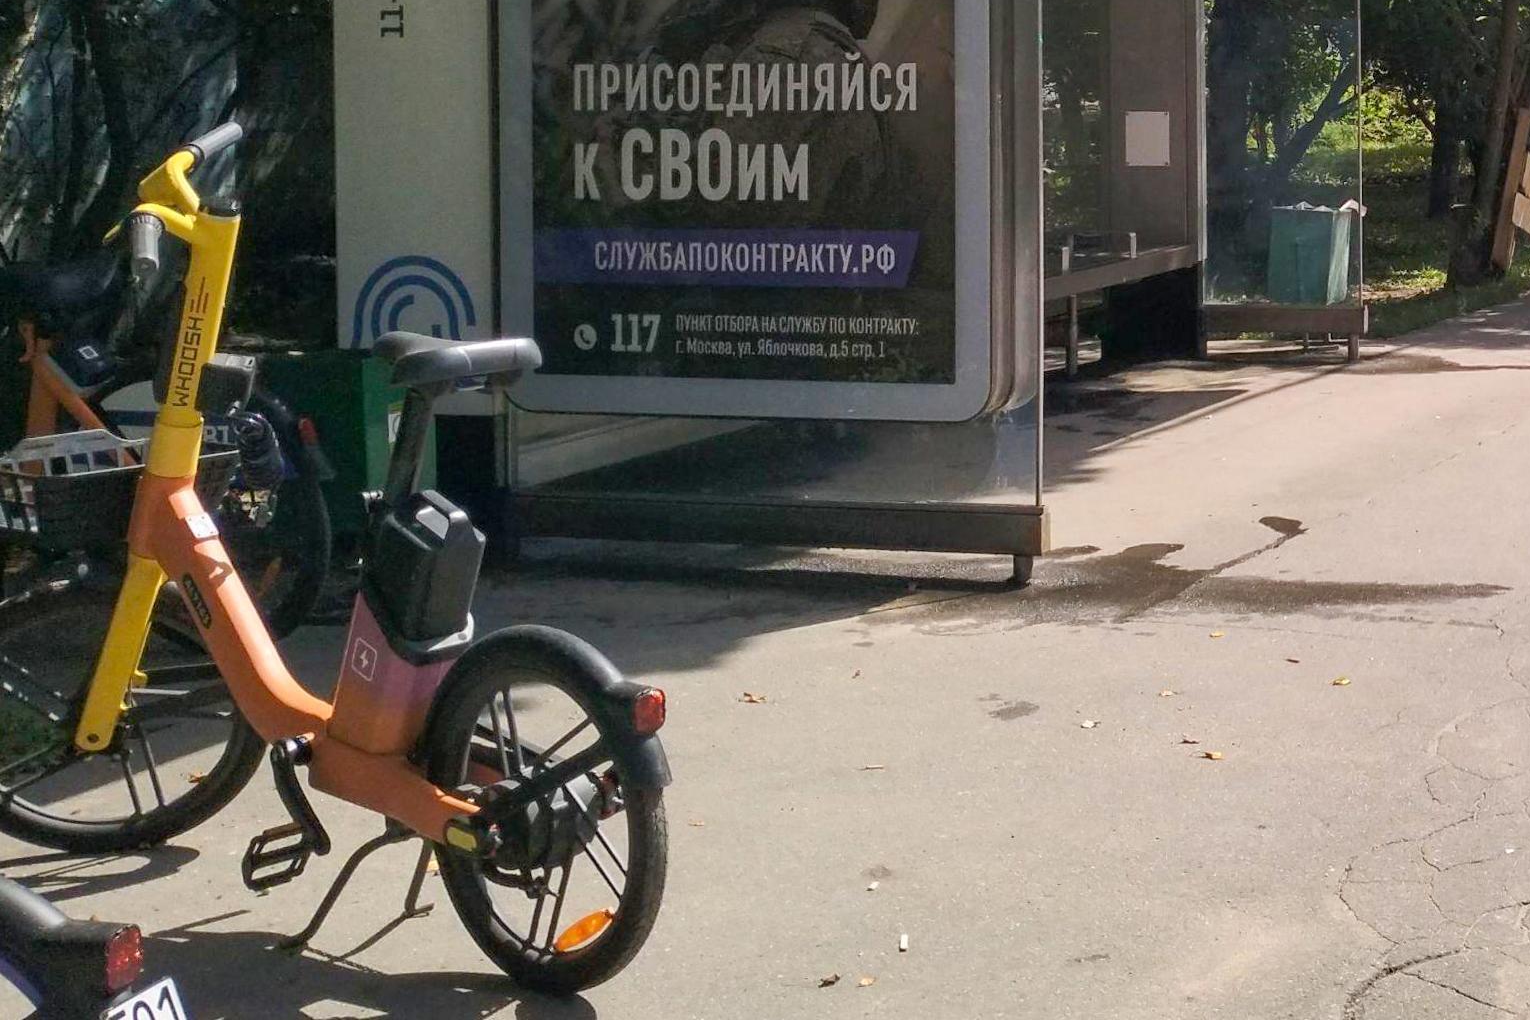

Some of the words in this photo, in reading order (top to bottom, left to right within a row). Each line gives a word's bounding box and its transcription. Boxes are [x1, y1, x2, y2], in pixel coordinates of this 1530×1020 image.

[573, 51, 918, 118] ПРИСОЕДИНЯЙСЯ
[594, 240, 897, 275] СЛУЖБАПОКОНТРАКТУ.РФ
[609, 313, 662, 354] 117
[675, 314, 713, 331] ПУНКТ
[715, 315, 760, 332] ОТБОРА
[762, 315, 778, 333] НА
[779, 315, 828, 333] СЛУЖБУ
[830, 317, 847, 334] ПО
[172, 316, 205, 407] WHOOSH
[687, 338, 736, 357] Москва,
[757, 339, 828, 358] Яблочкова,
[878, 341, 886, 358] 1
